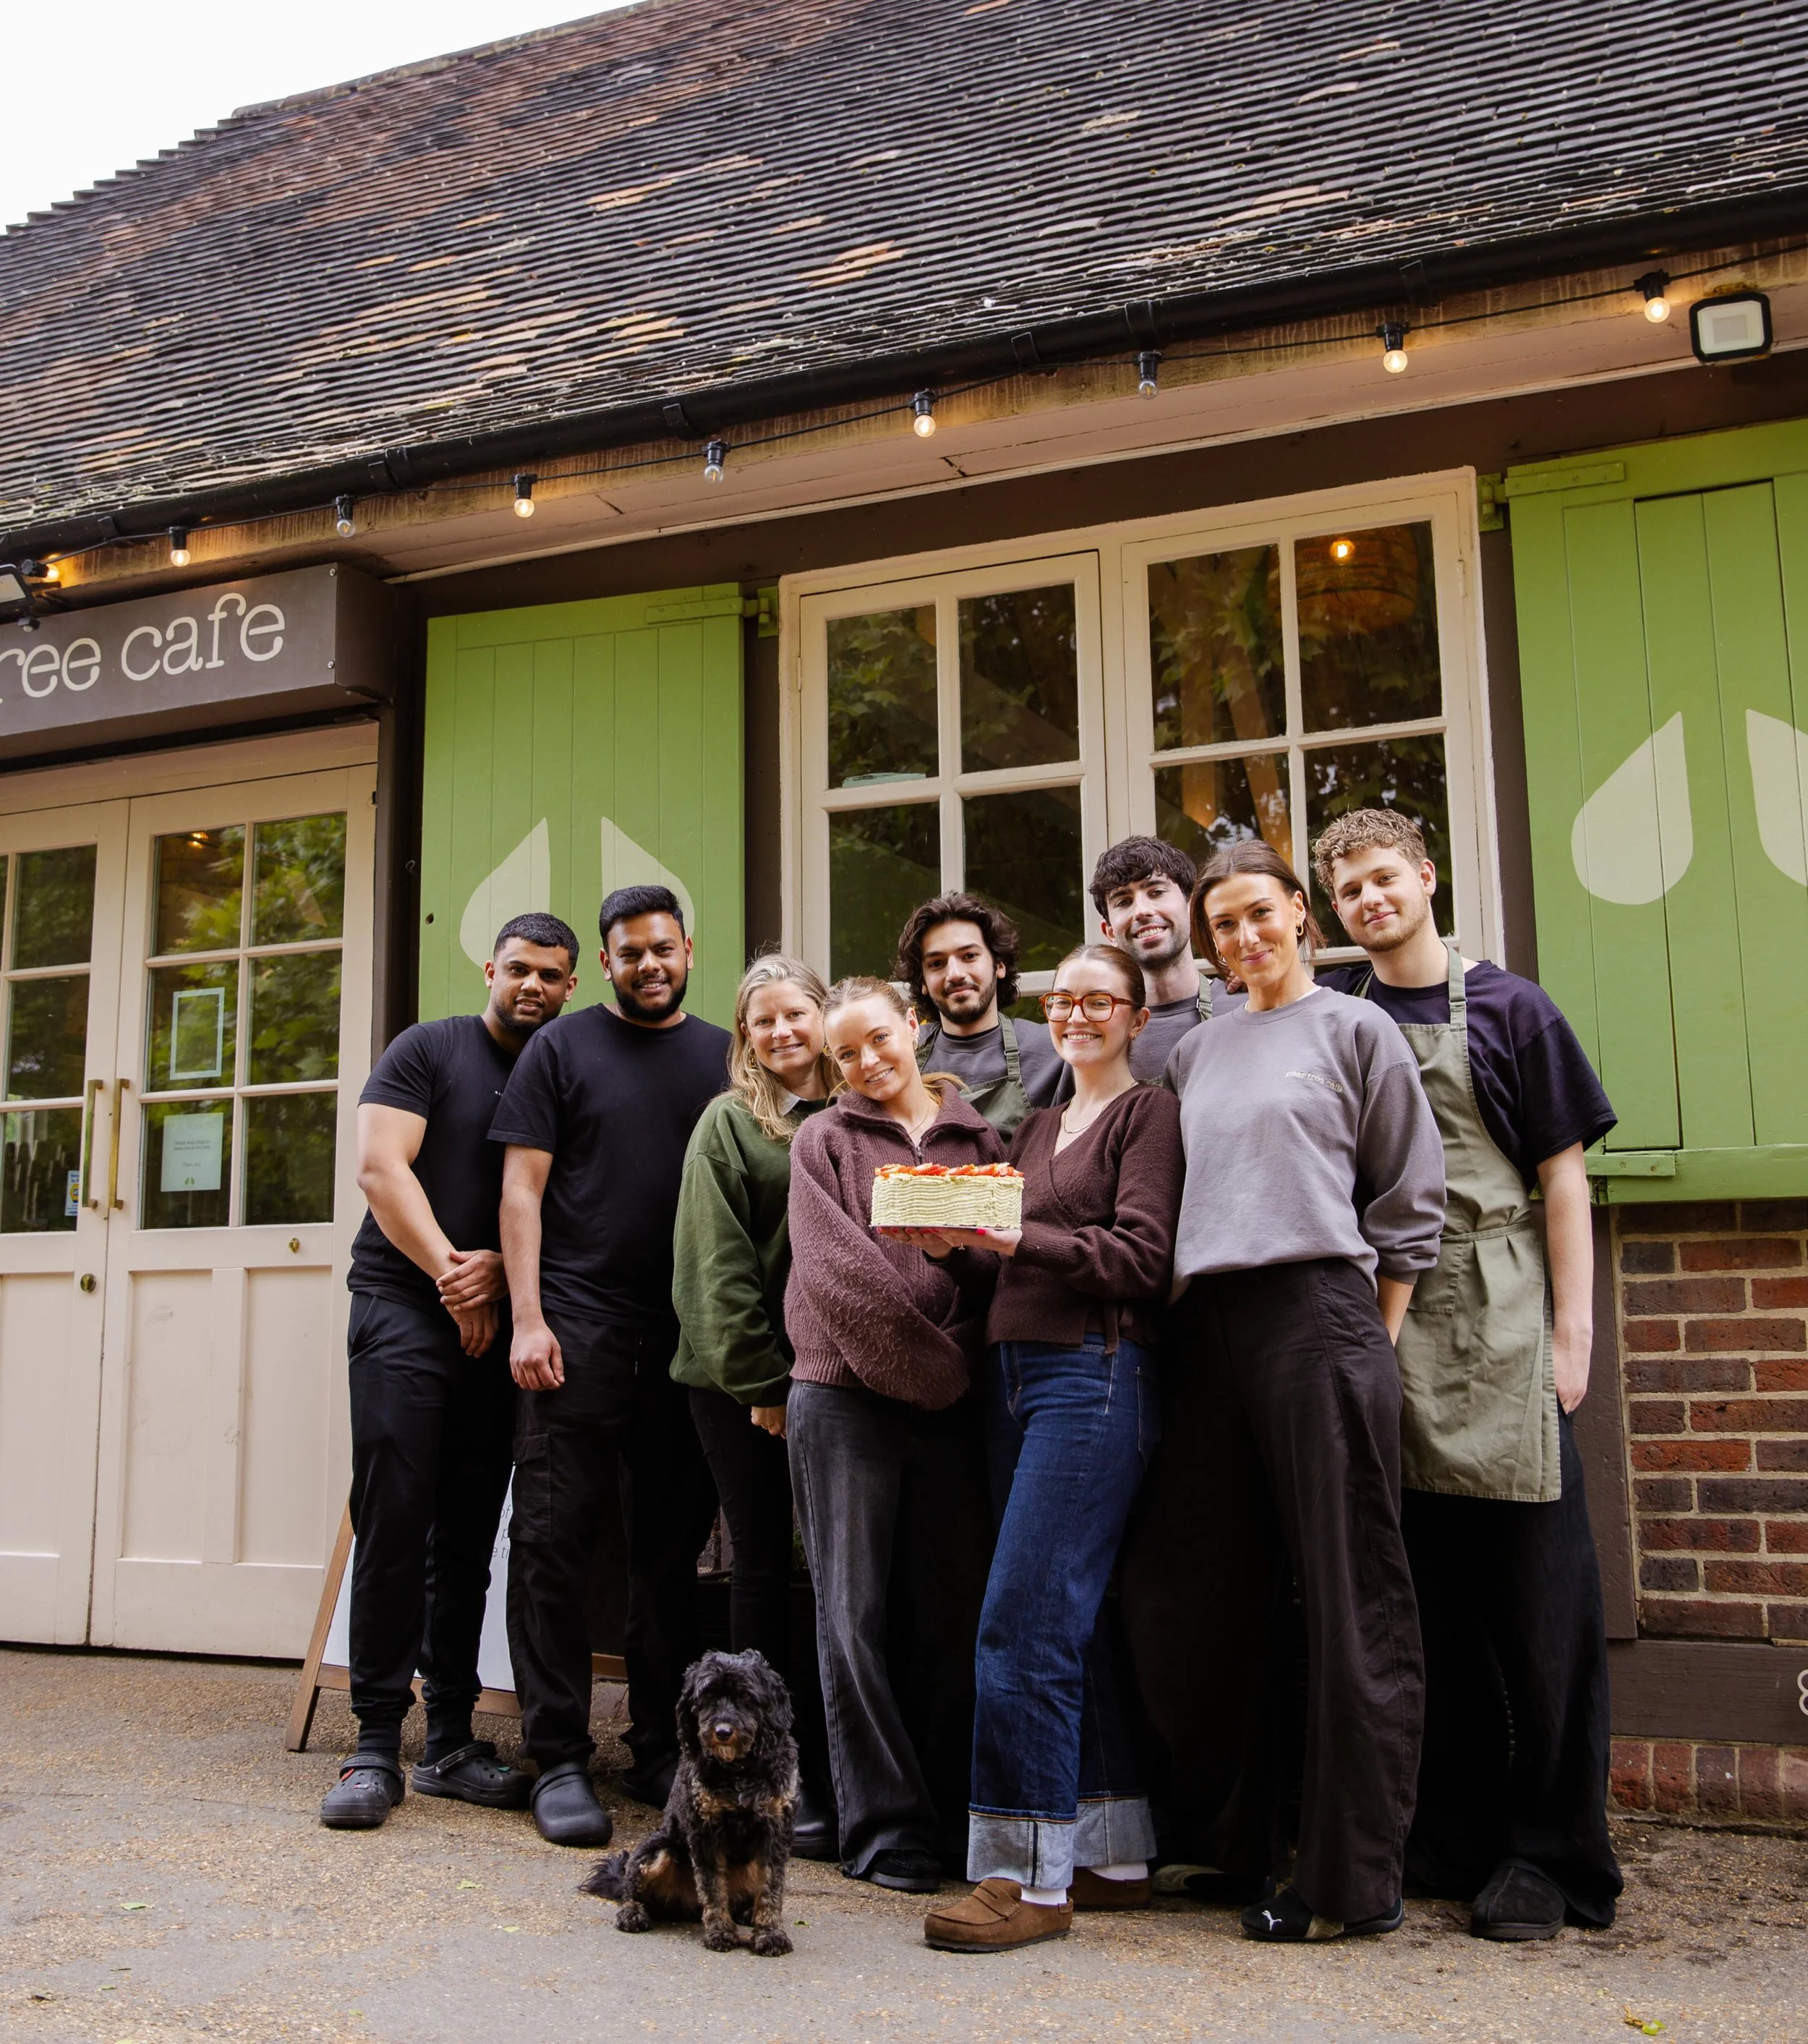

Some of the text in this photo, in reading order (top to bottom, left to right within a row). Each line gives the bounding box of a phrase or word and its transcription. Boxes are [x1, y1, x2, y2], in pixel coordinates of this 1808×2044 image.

[121, 592, 285, 681] cafe
[1308, 1073, 1324, 1083] tree
[1326, 1081, 1343, 1092] cafe
